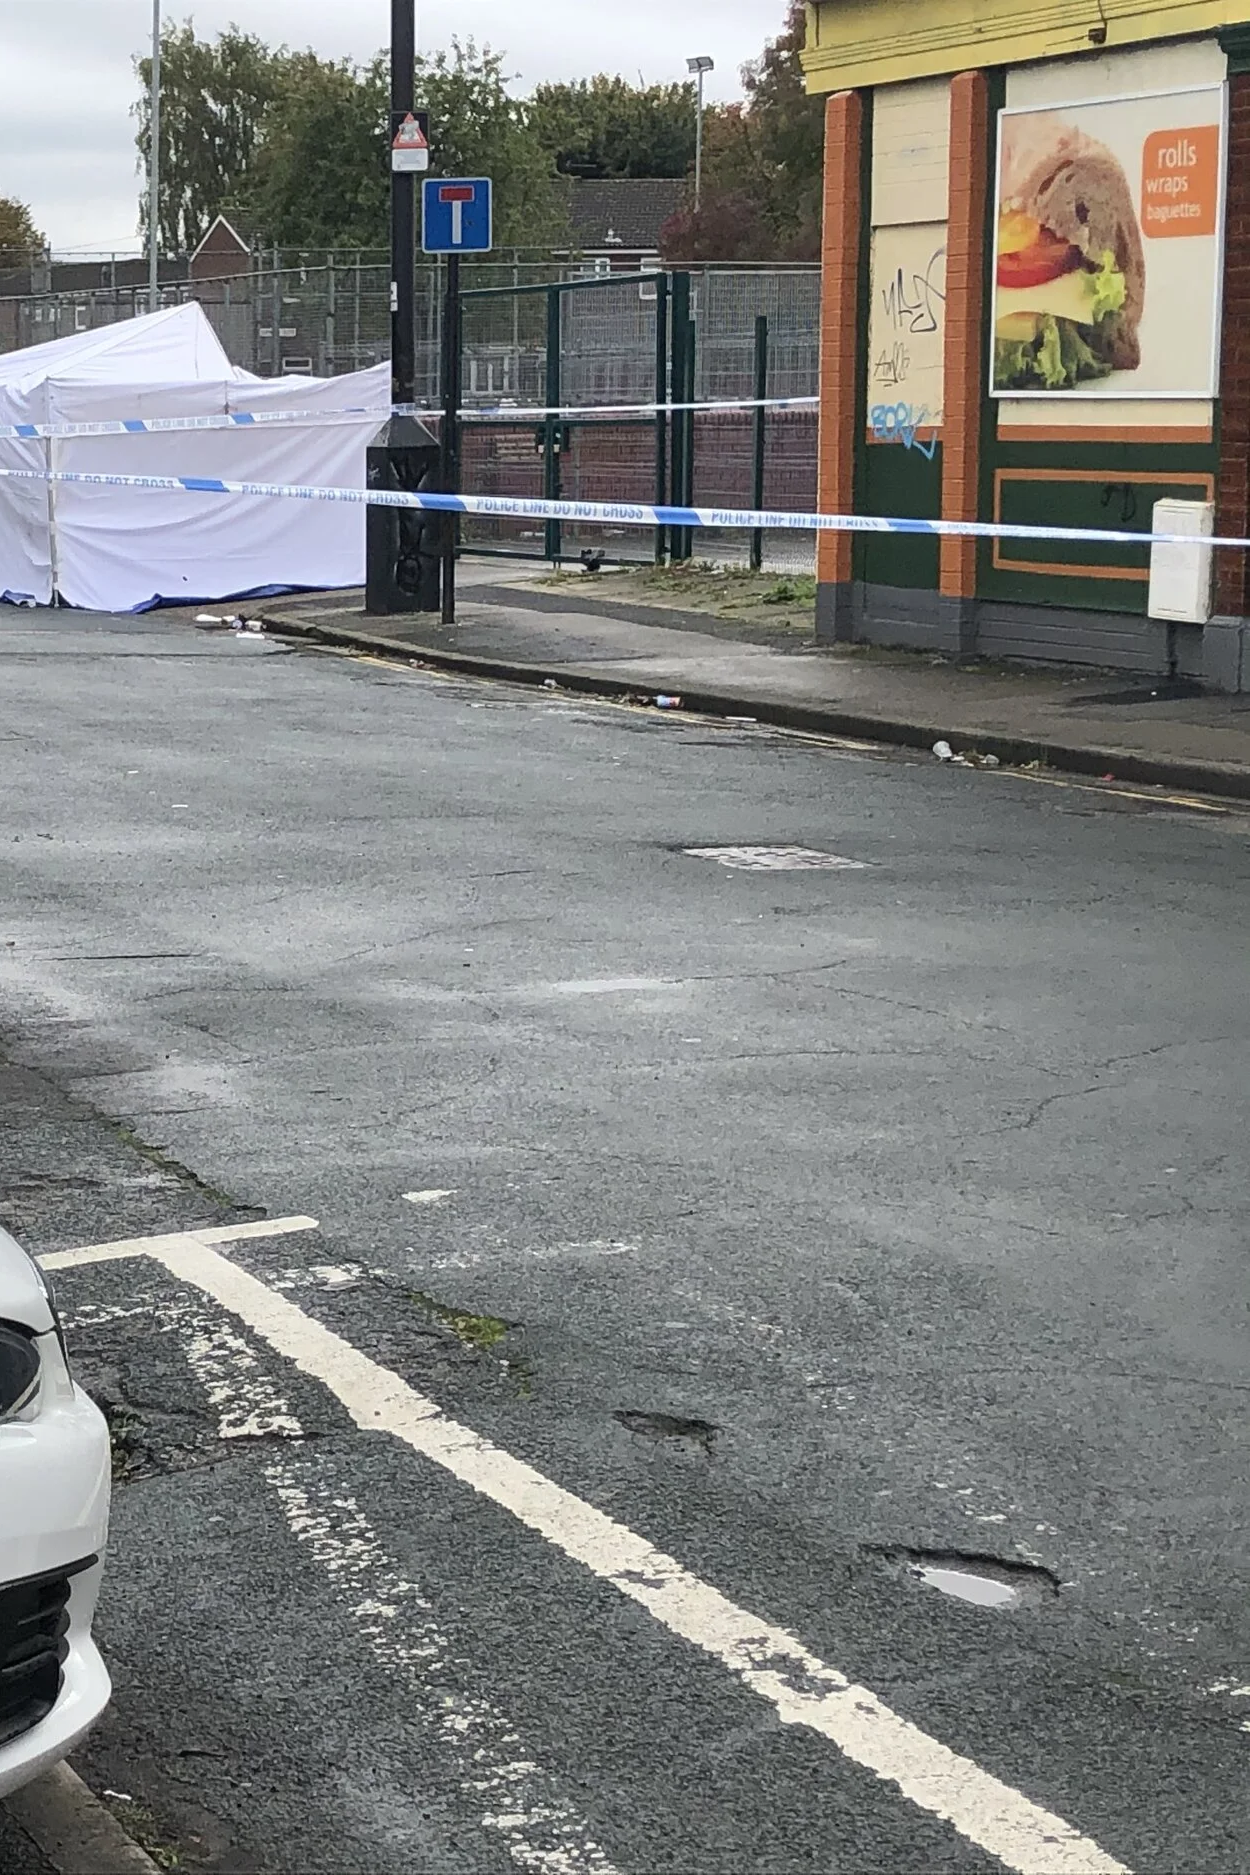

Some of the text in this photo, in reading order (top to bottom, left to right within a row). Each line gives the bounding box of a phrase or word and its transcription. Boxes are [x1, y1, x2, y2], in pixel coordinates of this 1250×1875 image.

[1158, 139, 1197, 169] rolls
[1146, 176, 1188, 198] wraps
[1146, 203, 1201, 223] baguettes
[241, 484, 284, 497] POLICE
[288, 487, 314, 499] LINE
[318, 489, 336, 501] DO
[339, 490, 363, 503] NOT
[476, 498, 519, 512] POLICE
[522, 501, 549, 514] LINE
[553, 502, 571, 516] DO
[574, 504, 598, 517] NOT
